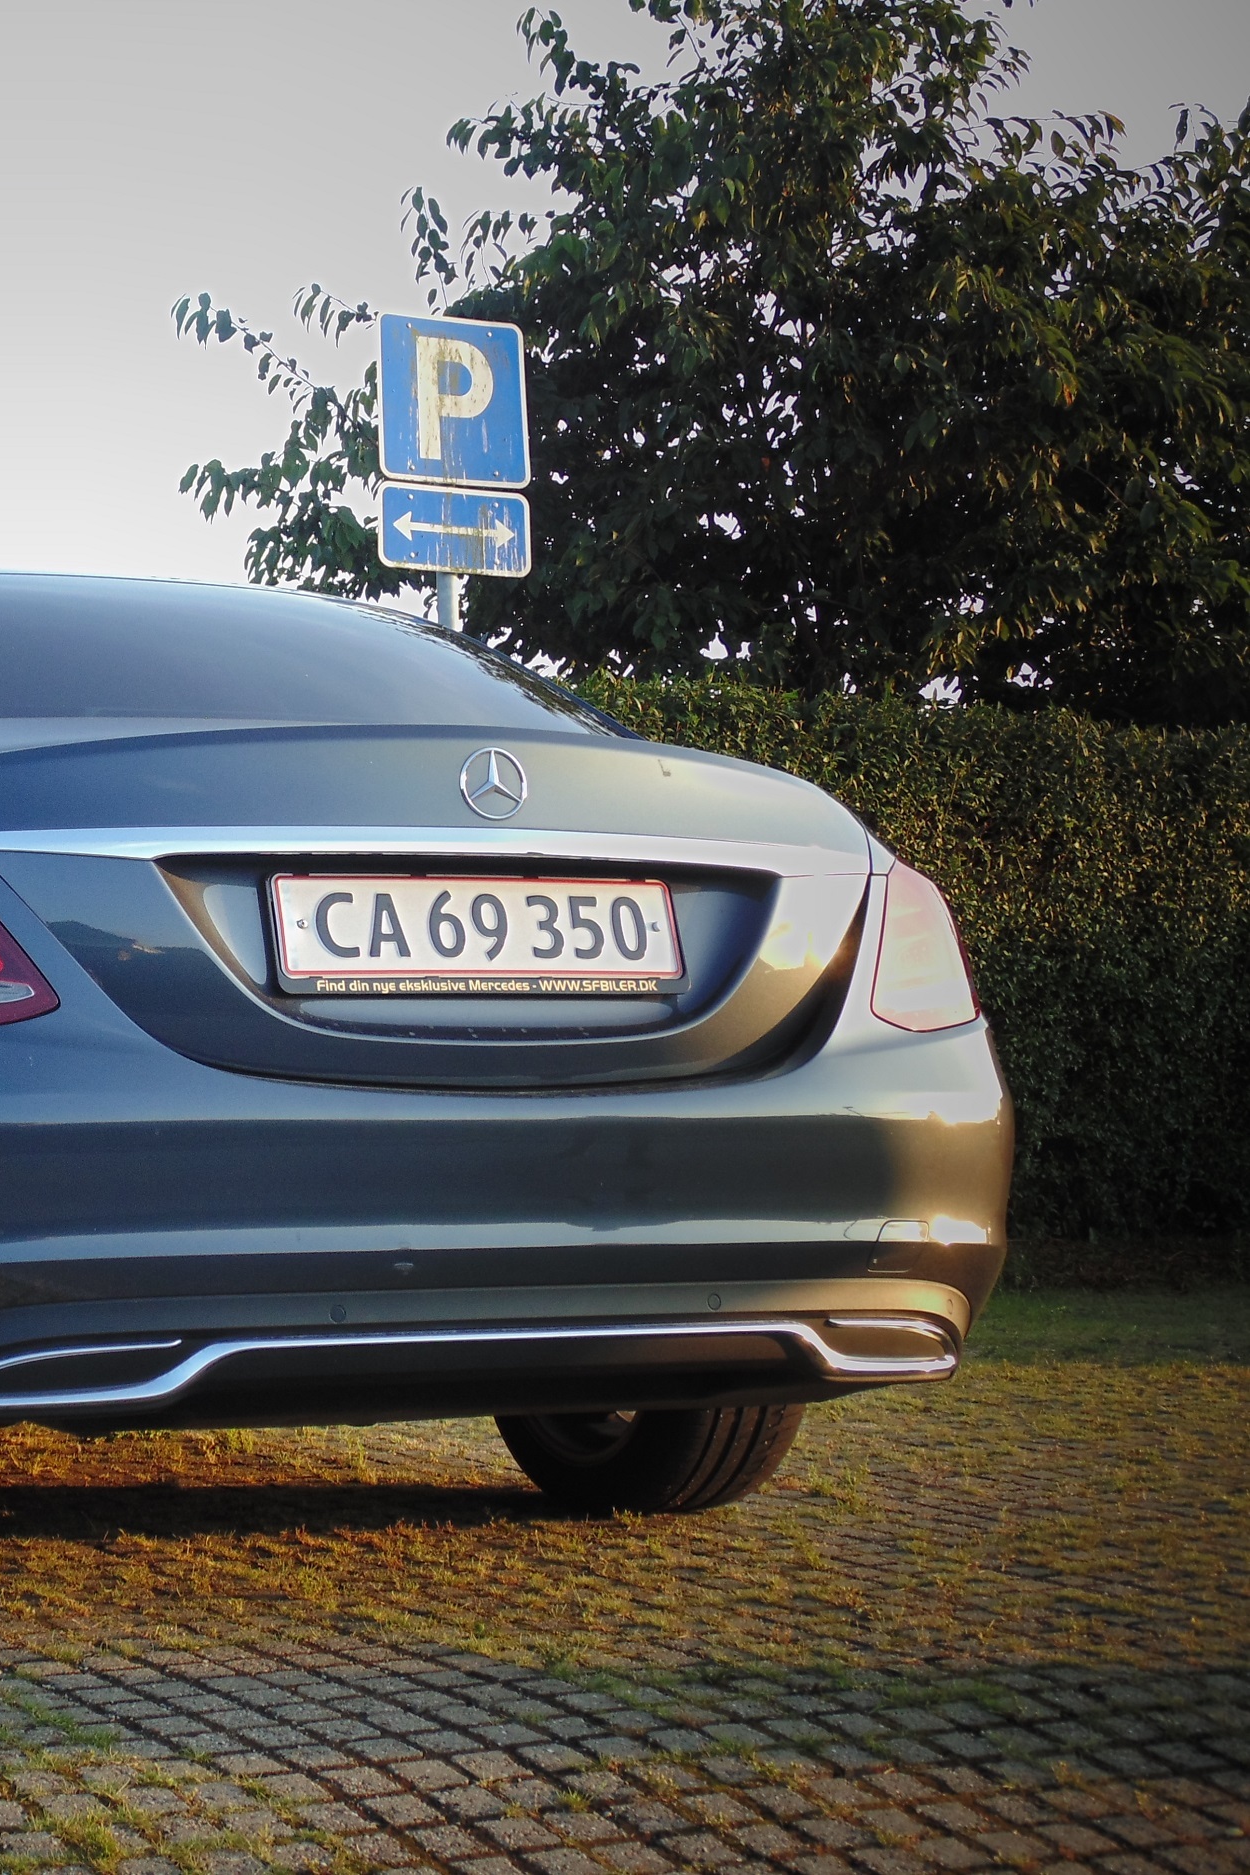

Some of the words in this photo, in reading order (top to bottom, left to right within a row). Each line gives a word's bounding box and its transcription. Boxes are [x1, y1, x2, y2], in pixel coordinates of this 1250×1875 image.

[417, 335, 494, 461] P
[315, 892, 411, 958] CA
[428, 890, 508, 961] 69
[526, 895, 647, 960] 350
[316, 980, 346, 991] Find
[349, 980, 369, 991] din
[373, 982, 395, 994] nye
[399, 980, 466, 991] eksklusive
[469, 980, 530, 991] Mercedes
[539, 979, 658, 992] WWW.SFBILER.DK
